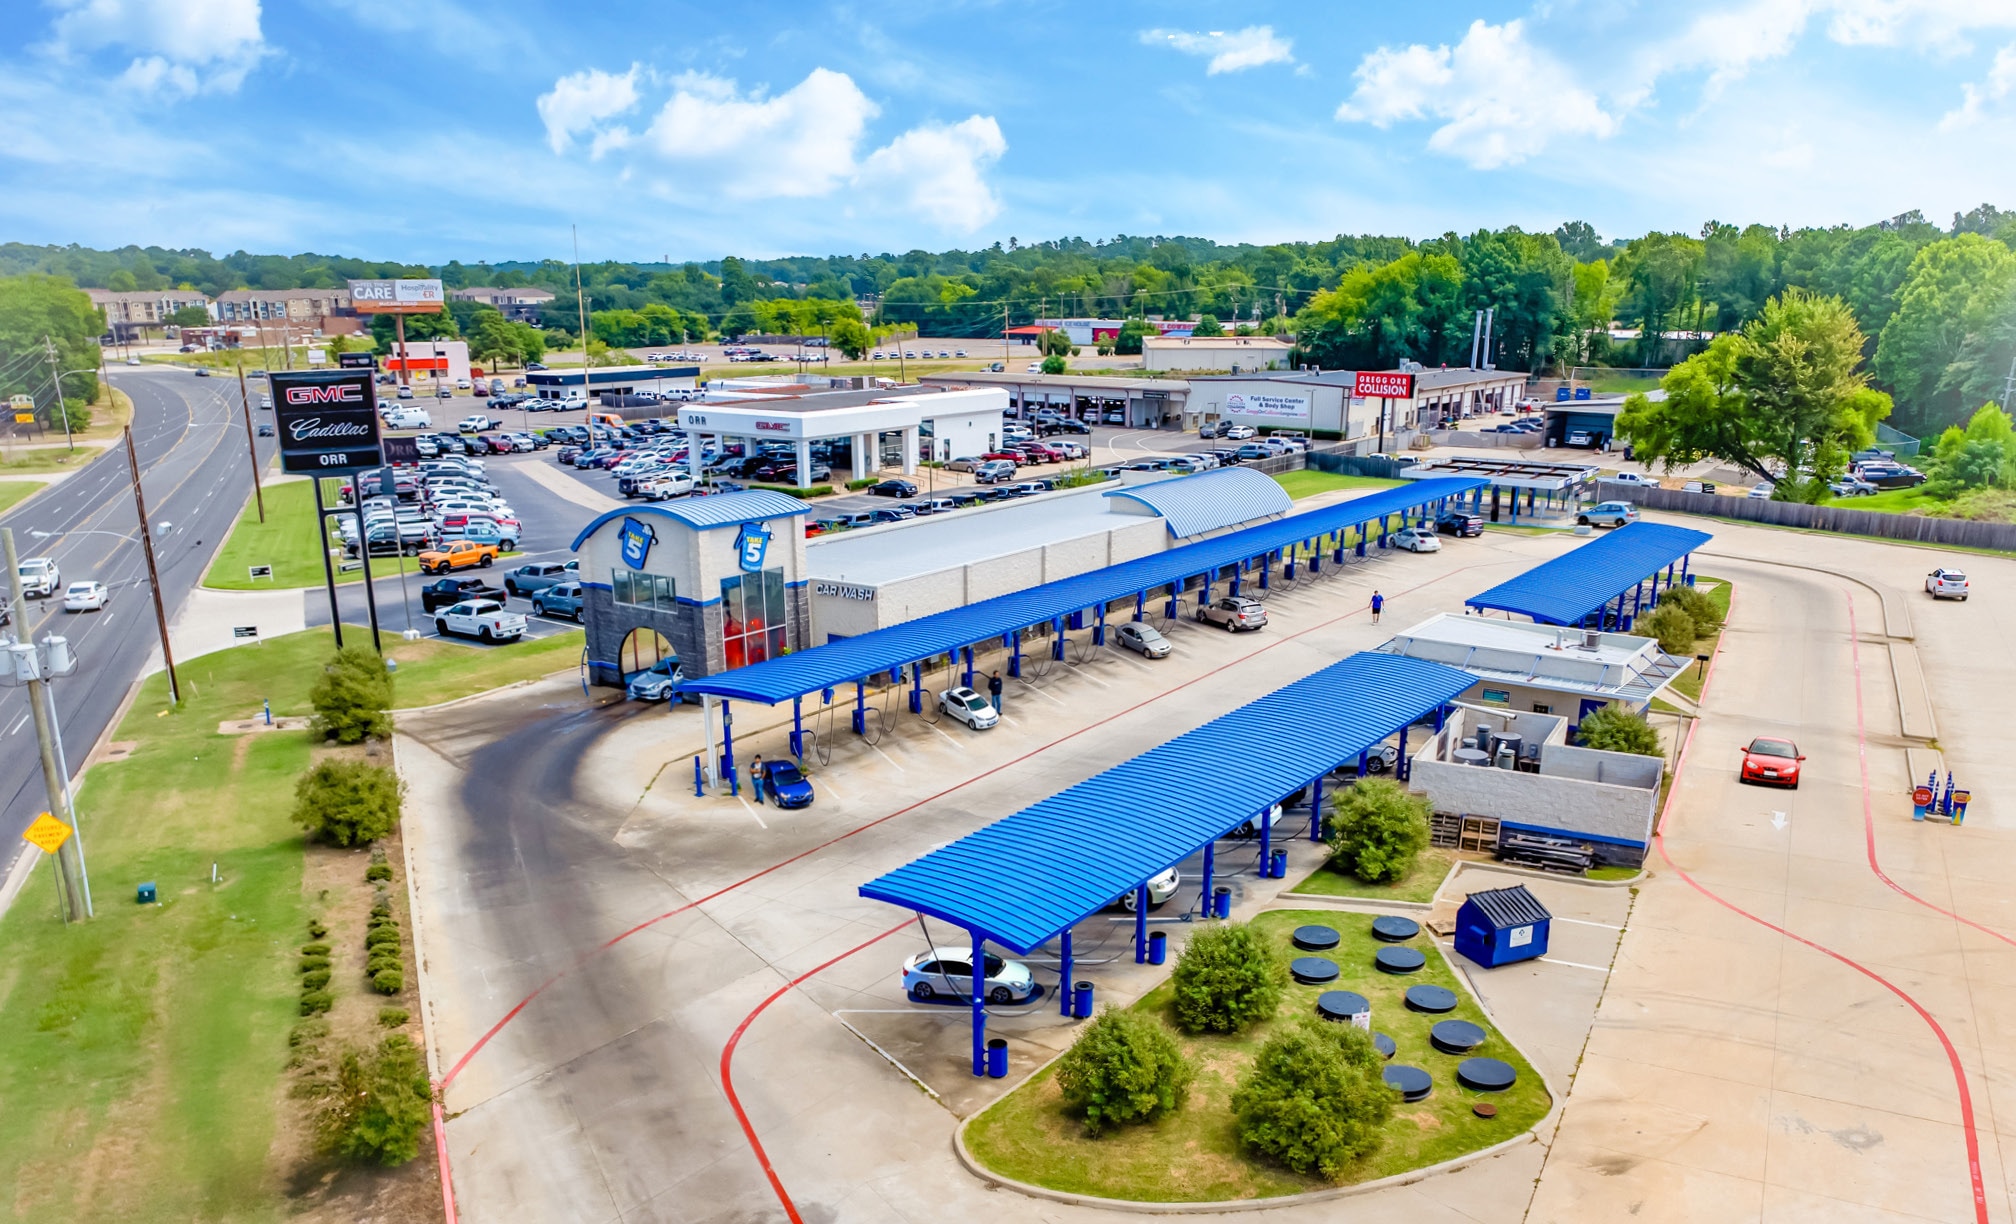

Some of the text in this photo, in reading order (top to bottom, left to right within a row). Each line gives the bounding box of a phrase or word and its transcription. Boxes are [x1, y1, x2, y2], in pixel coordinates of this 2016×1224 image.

[353, 287, 393, 299] CARE
[422, 290, 435, 299] ER
[1359, 375, 1407, 385] GREGG ORR
[285, 383, 363, 405] GMC
[1358, 383, 1407, 396] COLLISION
[688, 415, 707, 426] ORR
[755, 421, 791, 432] GMC
[289, 417, 369, 441] Cadillac
[319, 453, 348, 466] ORR
[628, 530, 645, 544] TAKE
[746, 536, 763, 544] TAKE
[626, 538, 643, 560] 5
[745, 543, 761, 563] 5
[816, 584, 875, 601] CAR WASH
